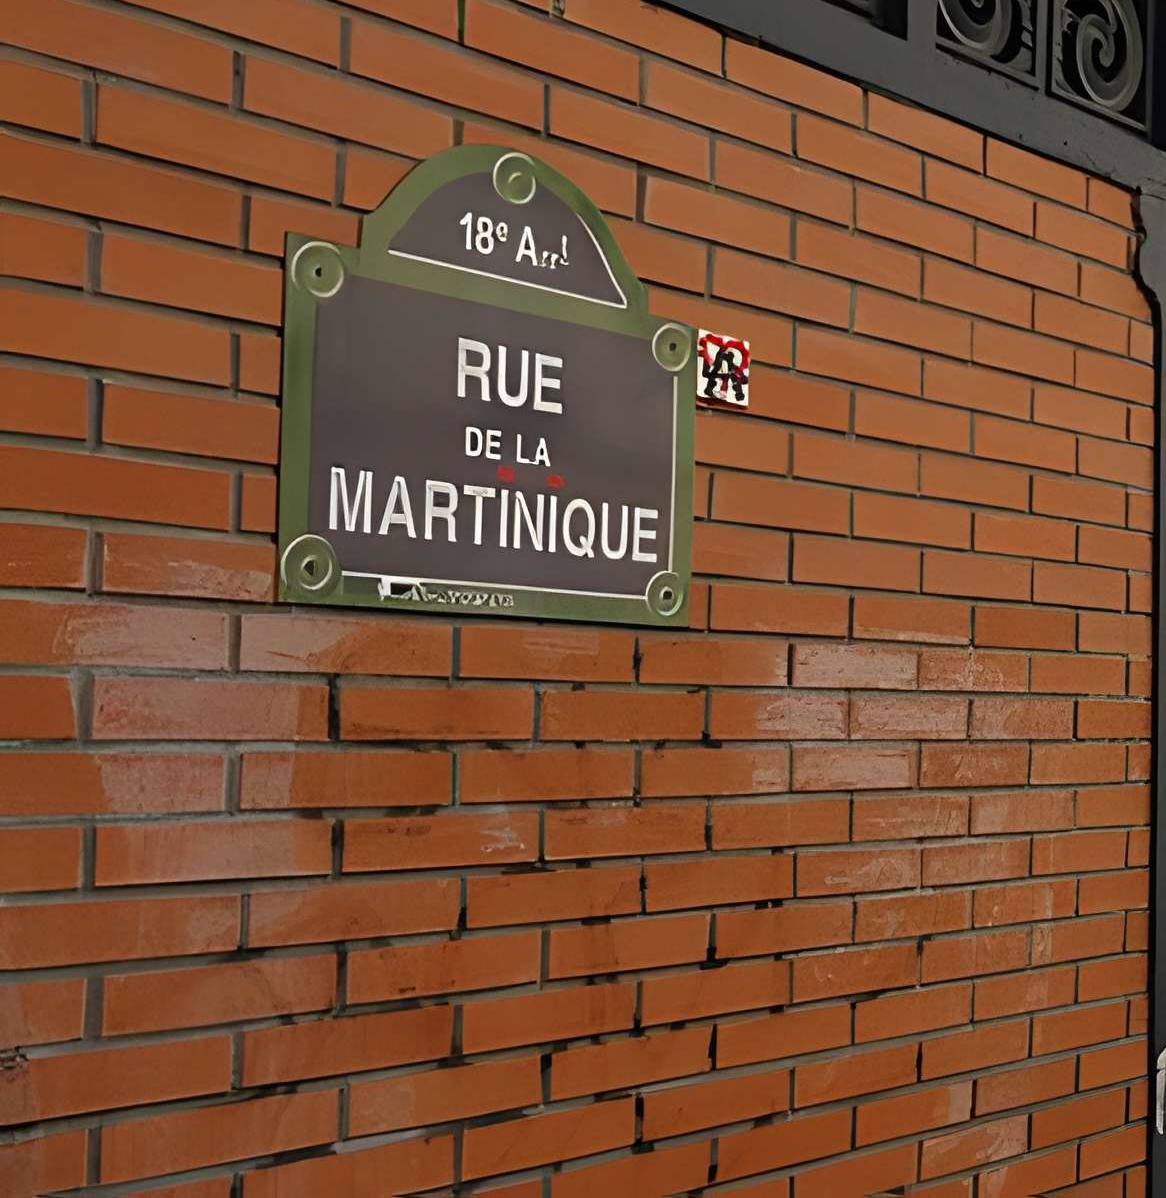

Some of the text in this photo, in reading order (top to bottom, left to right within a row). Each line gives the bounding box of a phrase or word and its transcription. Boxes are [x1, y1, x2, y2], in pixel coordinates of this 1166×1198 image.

[456, 337, 563, 414] RUE
[465, 426, 551, 467] DE LA
[328, 466, 659, 563] MARTINIQUE
